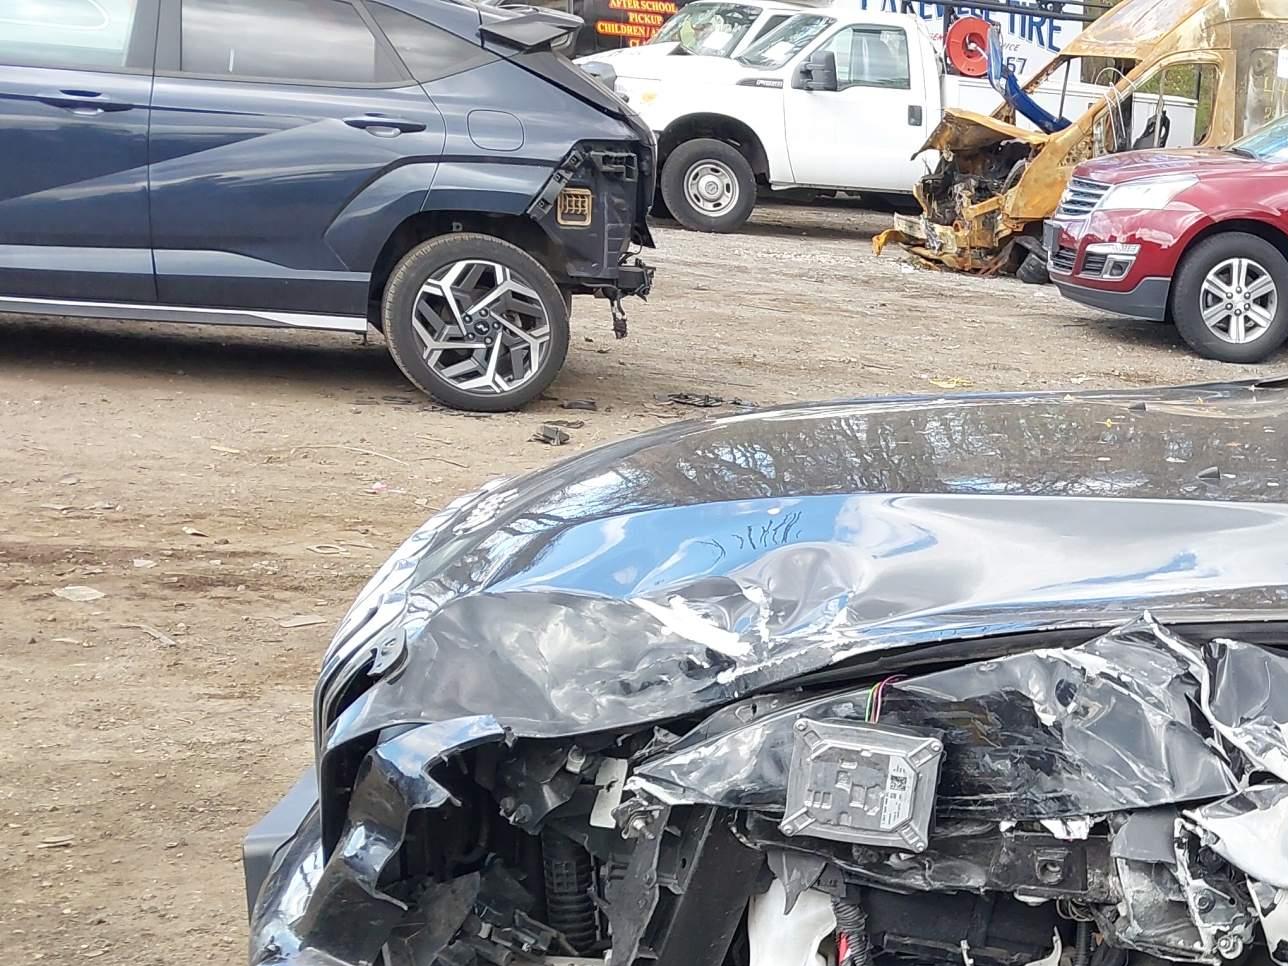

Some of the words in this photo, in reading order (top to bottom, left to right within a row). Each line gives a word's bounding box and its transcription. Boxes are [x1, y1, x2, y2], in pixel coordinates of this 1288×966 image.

[641, 1, 678, 13] SCHOOL
[628, 12, 664, 25] PICKUP
[597, 21, 645, 36] CHILDREN
[1003, 0, 1061, 53] TIRE
